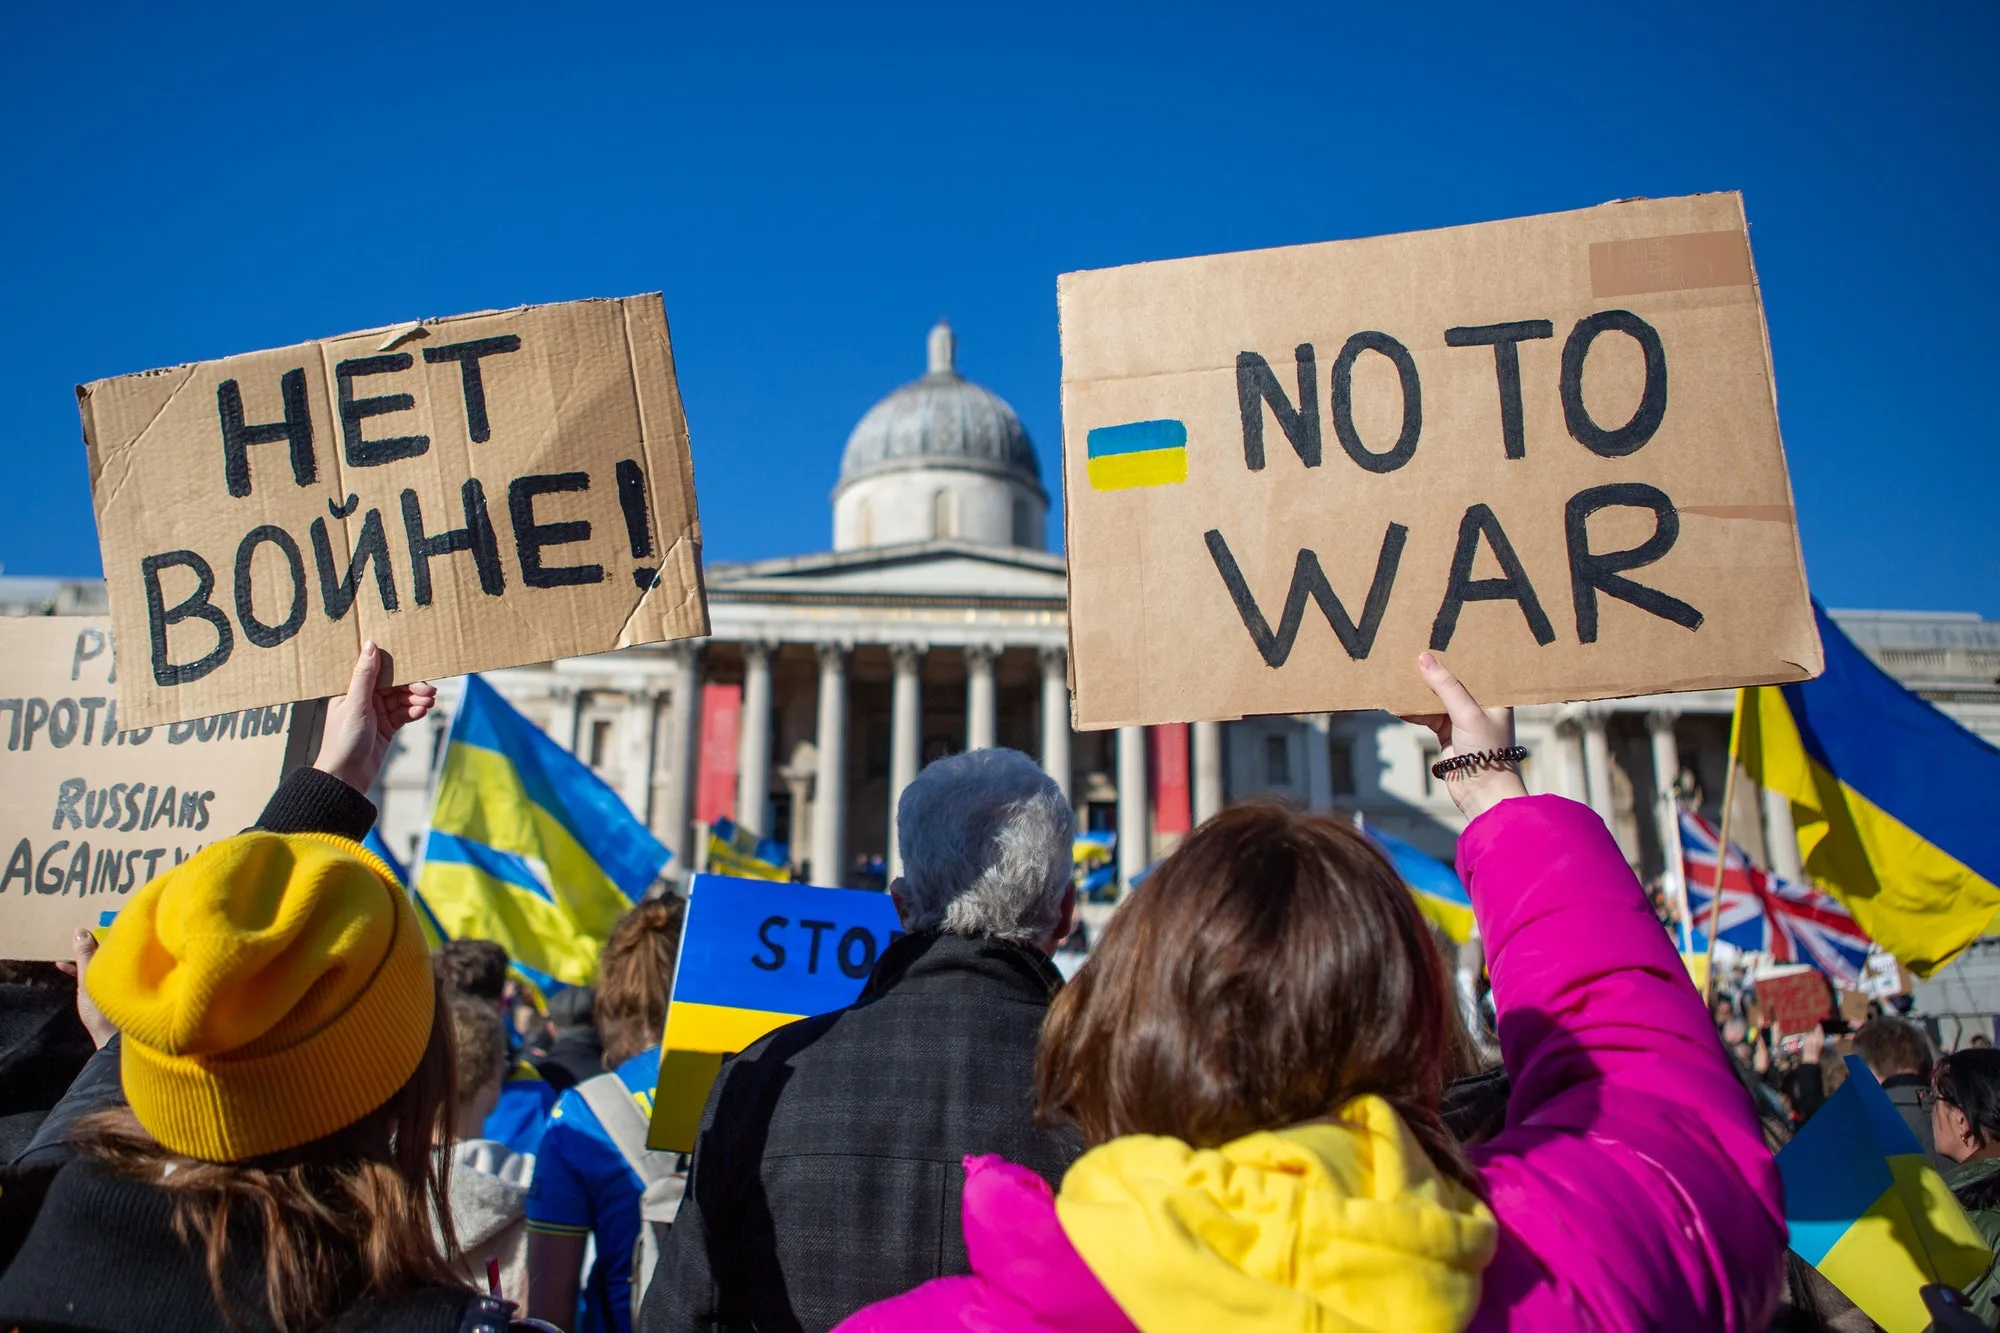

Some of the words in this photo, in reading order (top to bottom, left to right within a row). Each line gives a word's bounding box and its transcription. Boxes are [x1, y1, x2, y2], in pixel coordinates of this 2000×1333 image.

[217, 333, 522, 498] НЕТ
[1236, 330, 1422, 473] NO
[1444, 309, 1668, 459] TO
[142, 459, 663, 686] ВОЙНЕ!
[1204, 482, 1705, 668] WAR
[0, 837, 167, 898] AGAINST
[52, 777, 215, 832] RUSSIANS
[751, 915, 905, 979] STO
